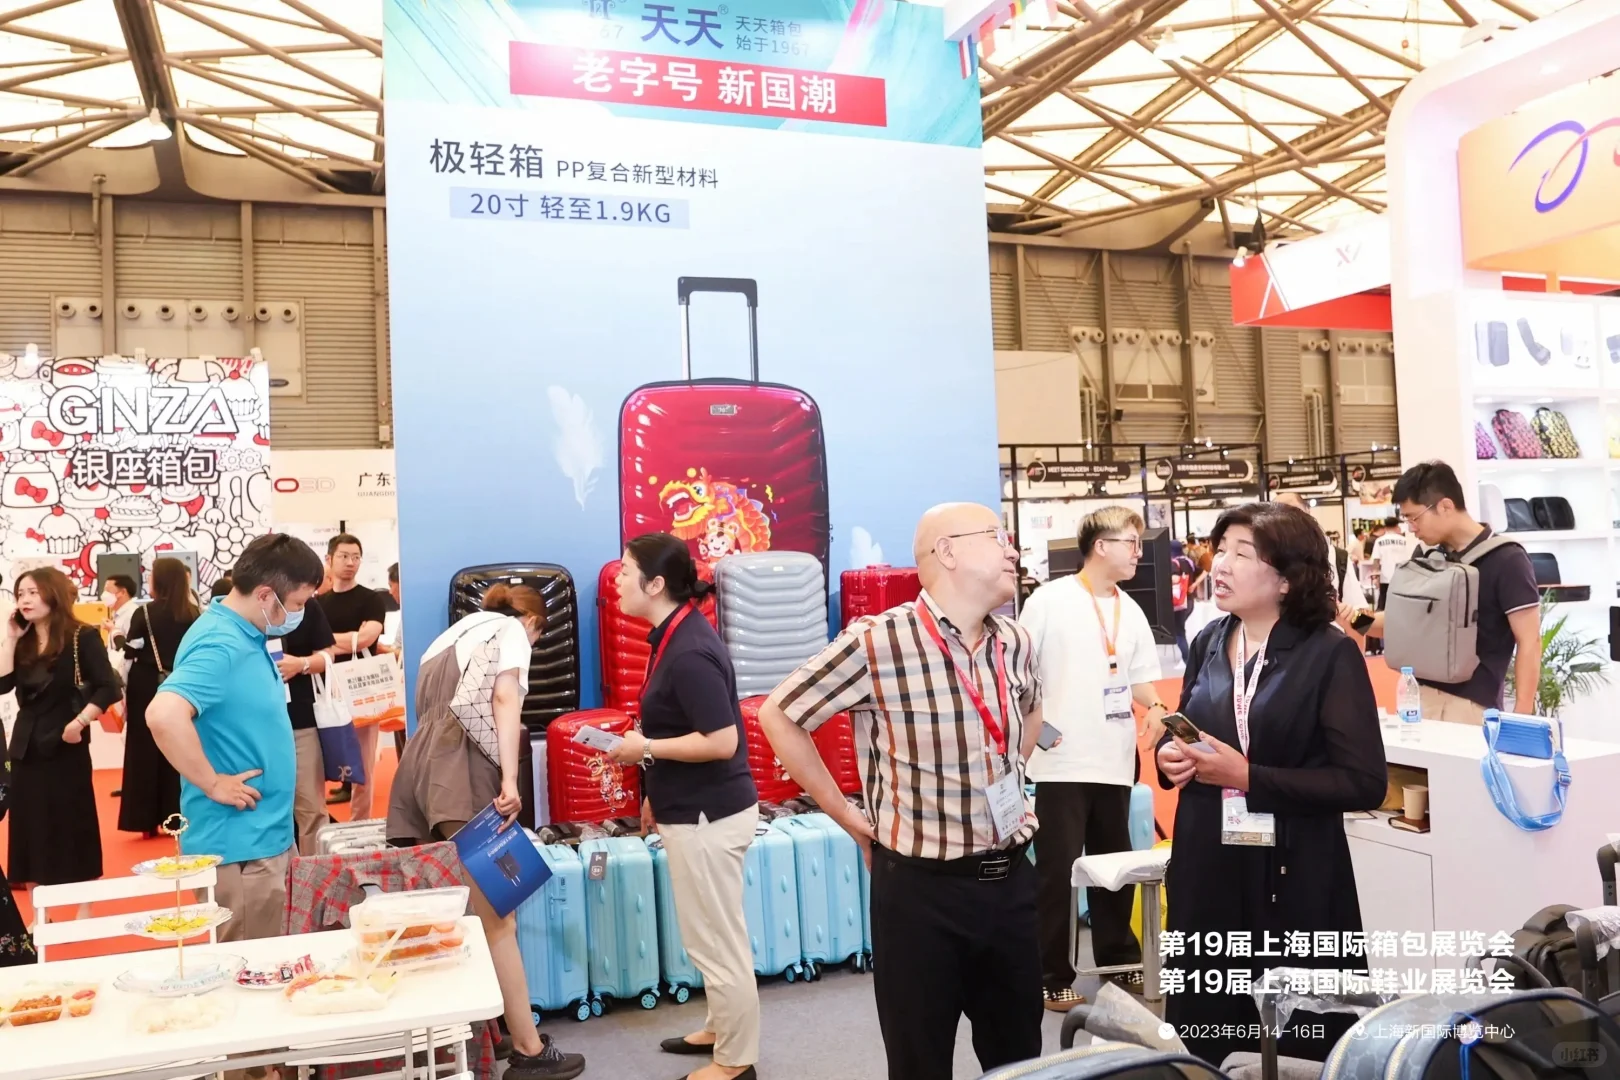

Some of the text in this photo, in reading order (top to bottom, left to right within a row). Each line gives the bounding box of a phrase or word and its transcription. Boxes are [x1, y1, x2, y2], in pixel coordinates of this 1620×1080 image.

[641, 3, 724, 49] 天天
[735, 15, 801, 36] 天天箱包
[735, 34, 810, 55] 始于1967
[572, 53, 838, 114] 老字号 新国潮
[430, 137, 719, 189] 极轻箱 PP复合新型材料
[470, 192, 671, 224] 20寸 轻至1.9KG
[48, 385, 239, 435] GNZA
[72, 449, 218, 485] 银座箱包
[358, 472, 391, 487] 广东
